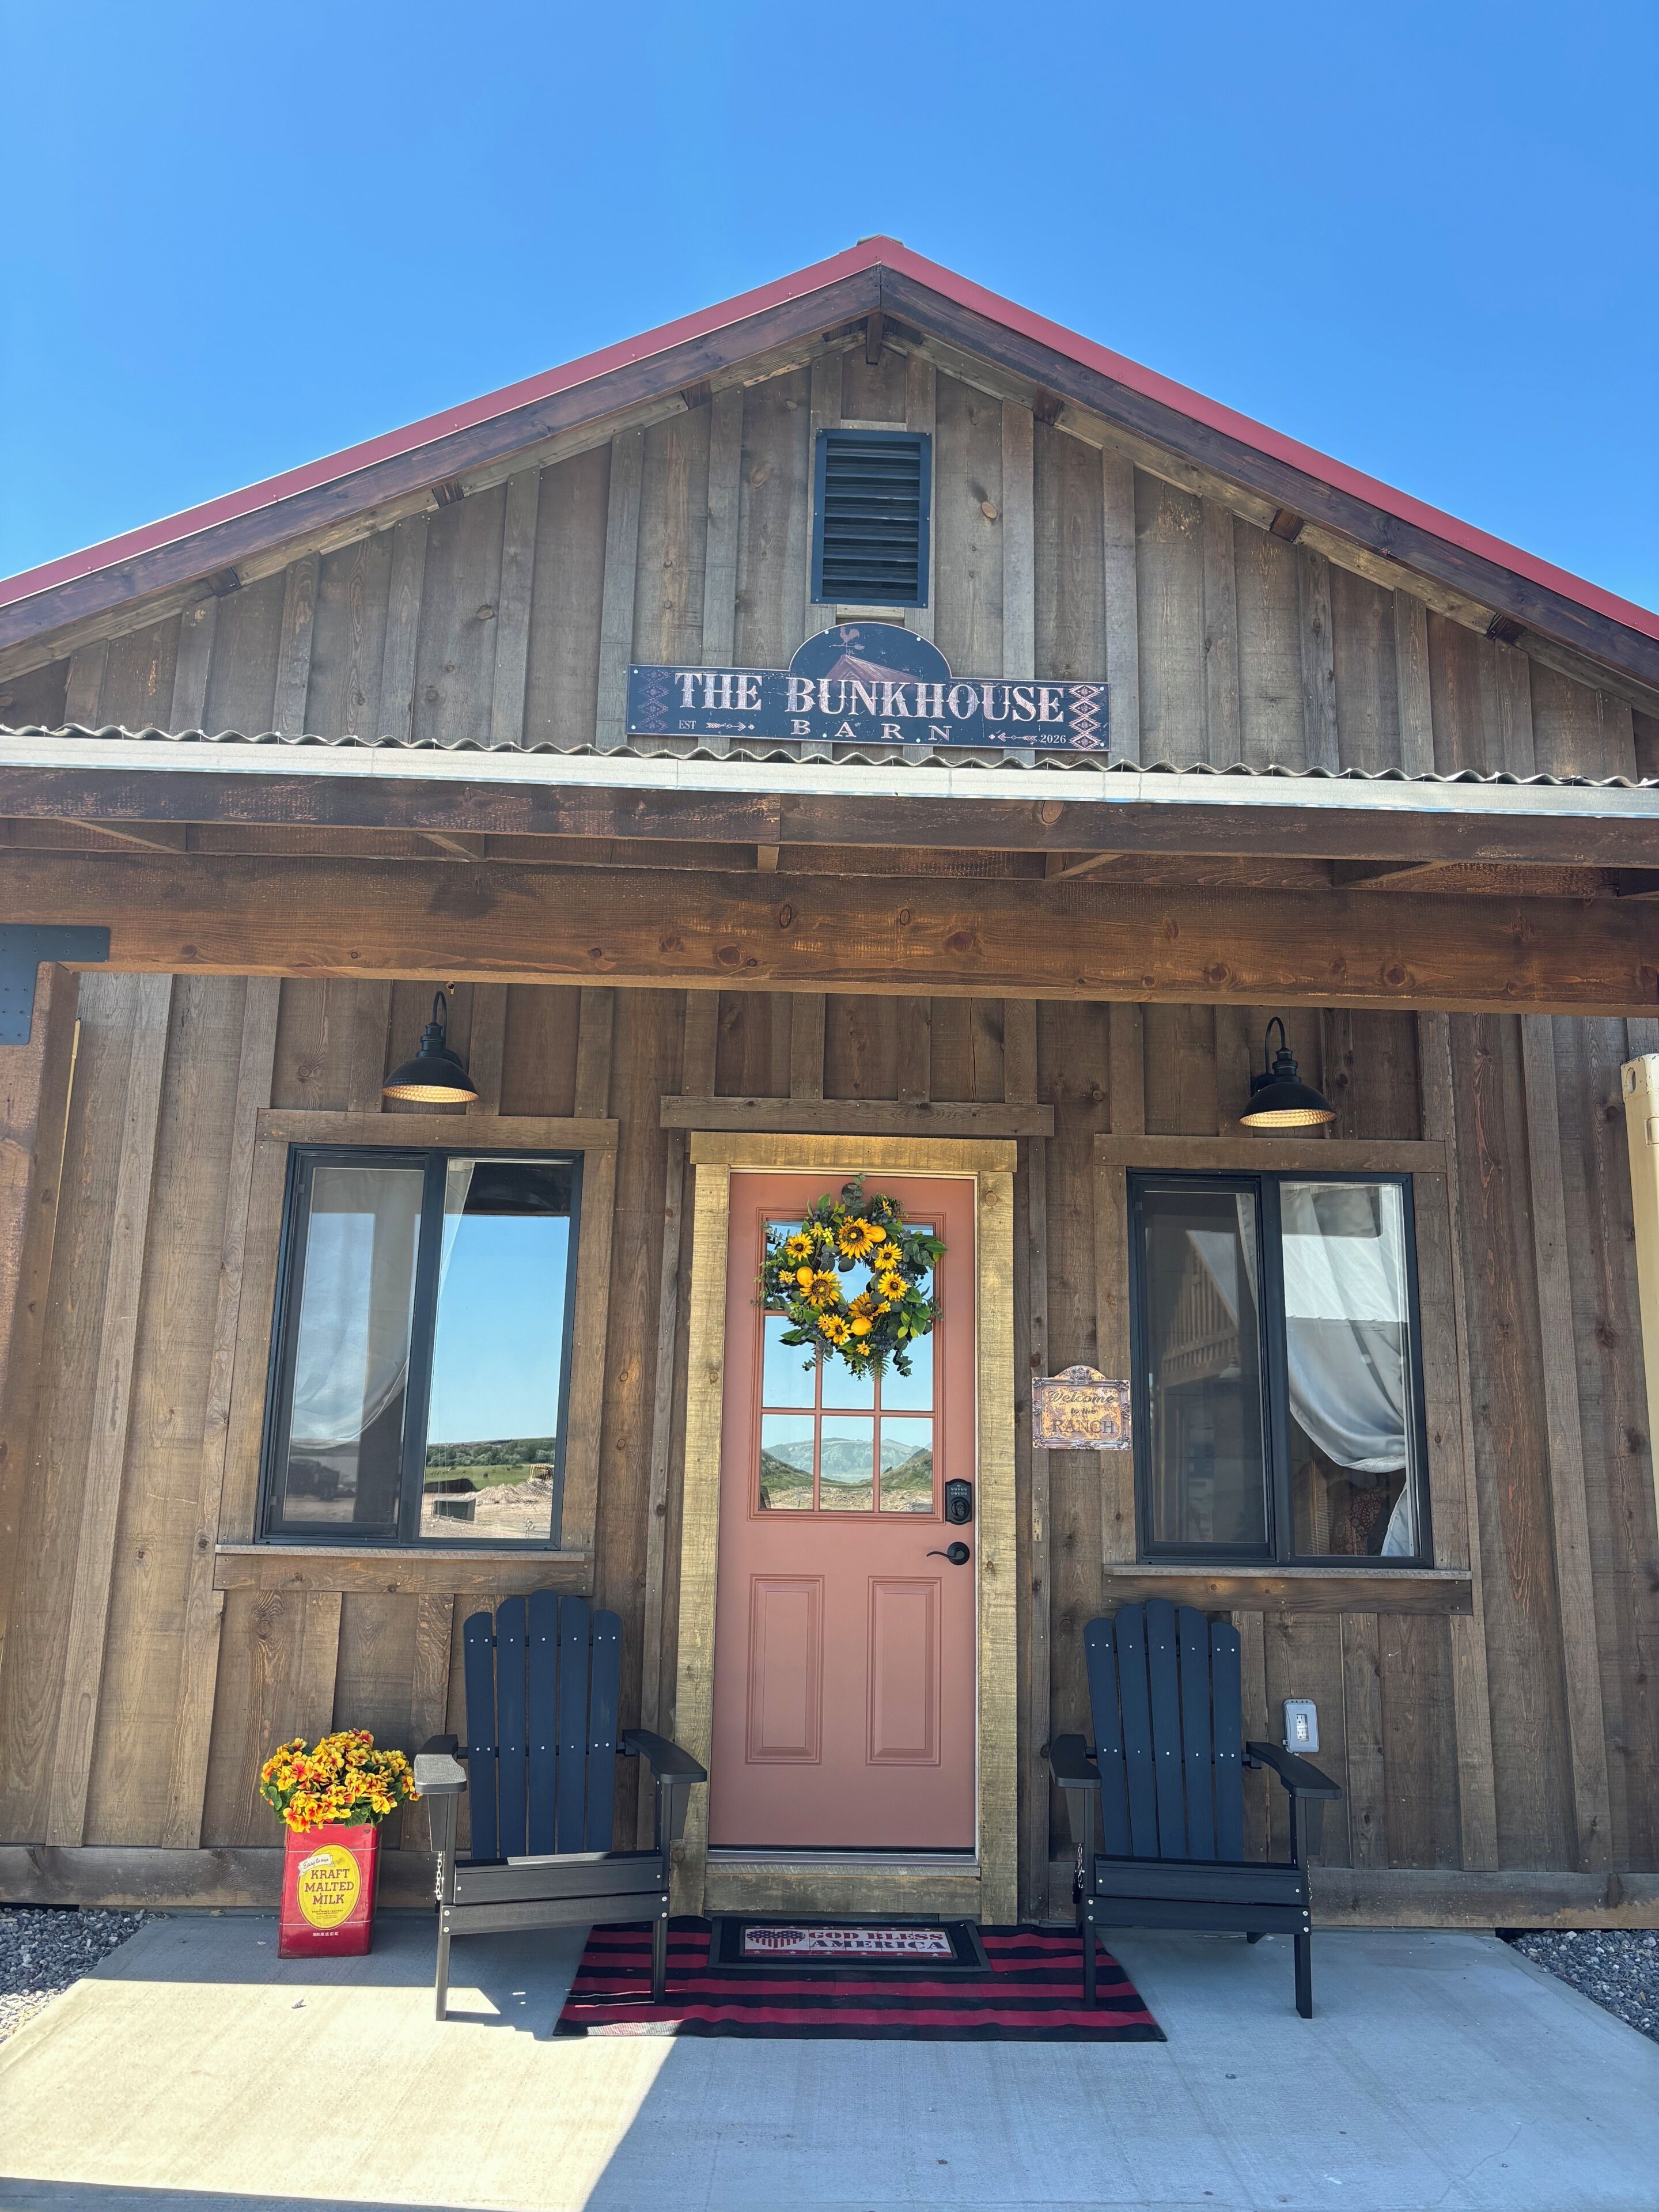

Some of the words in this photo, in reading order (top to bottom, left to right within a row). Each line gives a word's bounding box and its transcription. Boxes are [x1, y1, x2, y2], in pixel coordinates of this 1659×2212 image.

[675, 673, 763, 711] THE
[785, 677, 1065, 723] BUNKHOUSE
[678, 720, 697, 730] EST
[1040, 733, 1067, 744] 2026
[1048, 1391, 1115, 1403] Welcome
[1052, 1419, 1115, 1434] RANCH
[303, 1861, 315, 1869] Easy
[310, 1869, 350, 1879] KRAFT
[305, 1881, 354, 1892] MALTED
[313, 1894, 344, 1904] MILK
[810, 1940, 947, 1949] AMERICA
